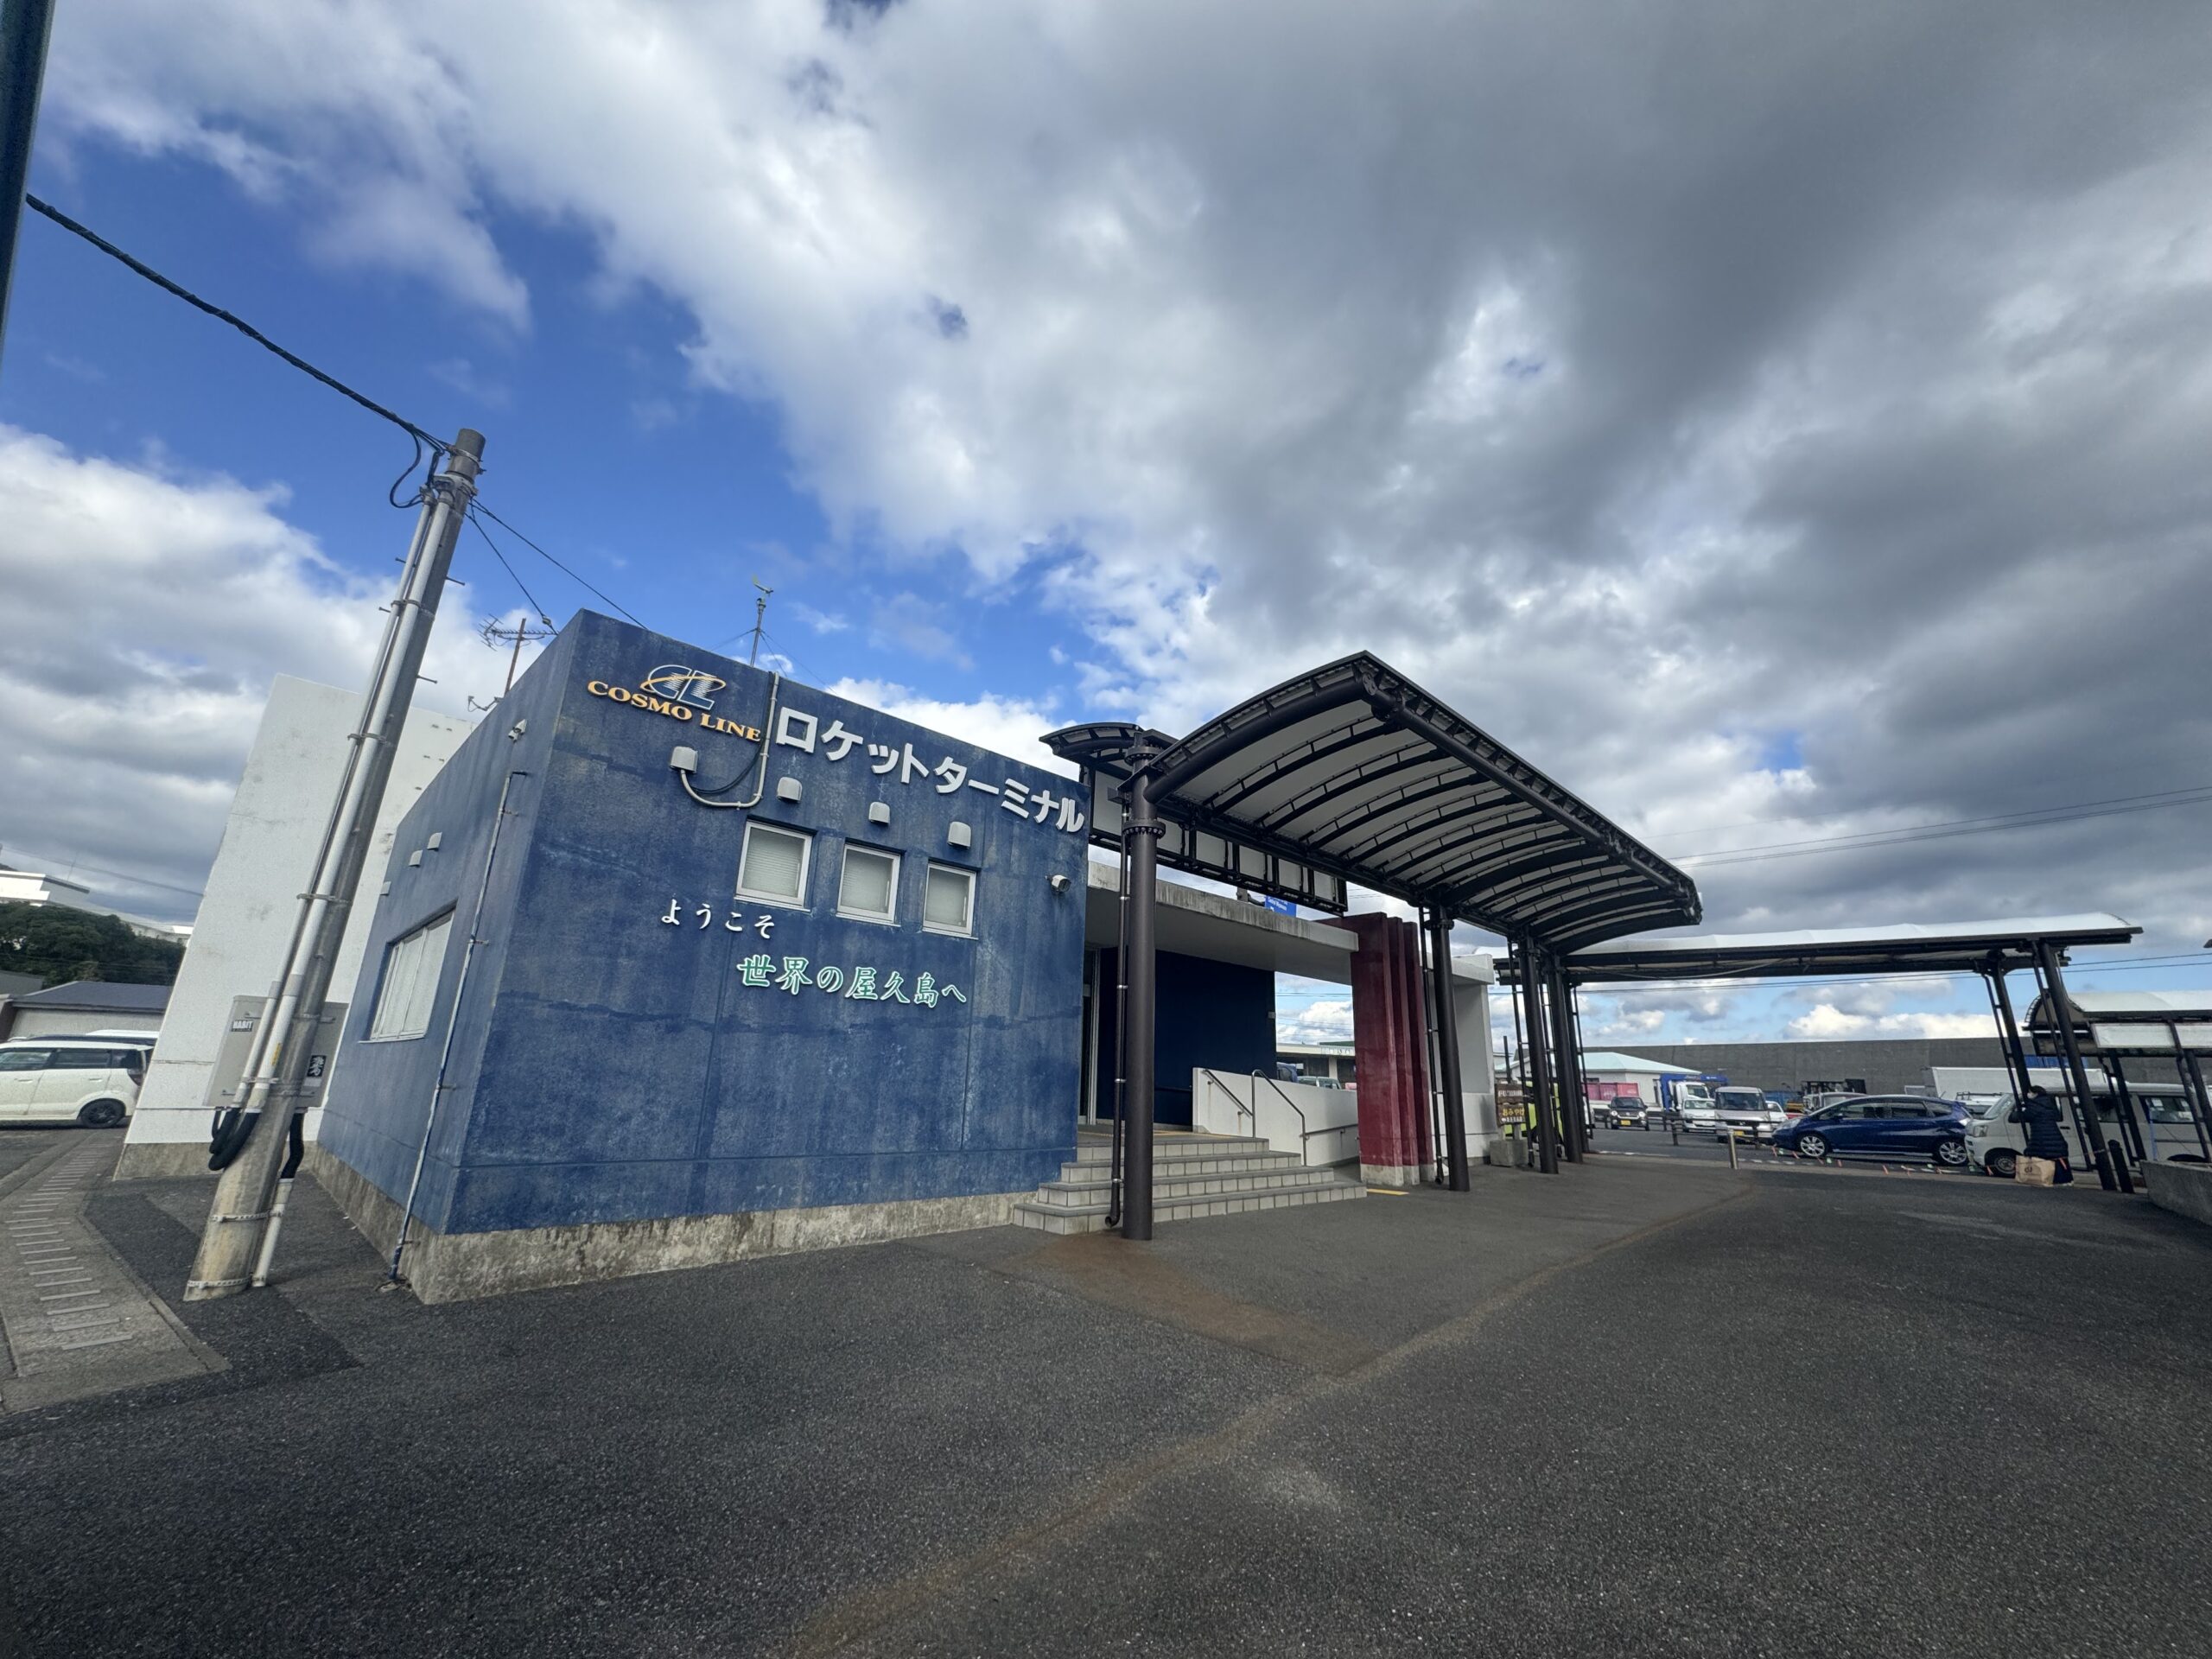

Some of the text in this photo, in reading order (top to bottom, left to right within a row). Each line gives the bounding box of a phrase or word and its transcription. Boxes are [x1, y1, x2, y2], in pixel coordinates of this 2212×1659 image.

[588, 680, 761, 742] COSMO LINE
[776, 706, 1085, 833] ロケットターミナル
[661, 899, 775, 939] ようこそ
[736, 954, 967, 1009] 世界の屋久島へ
